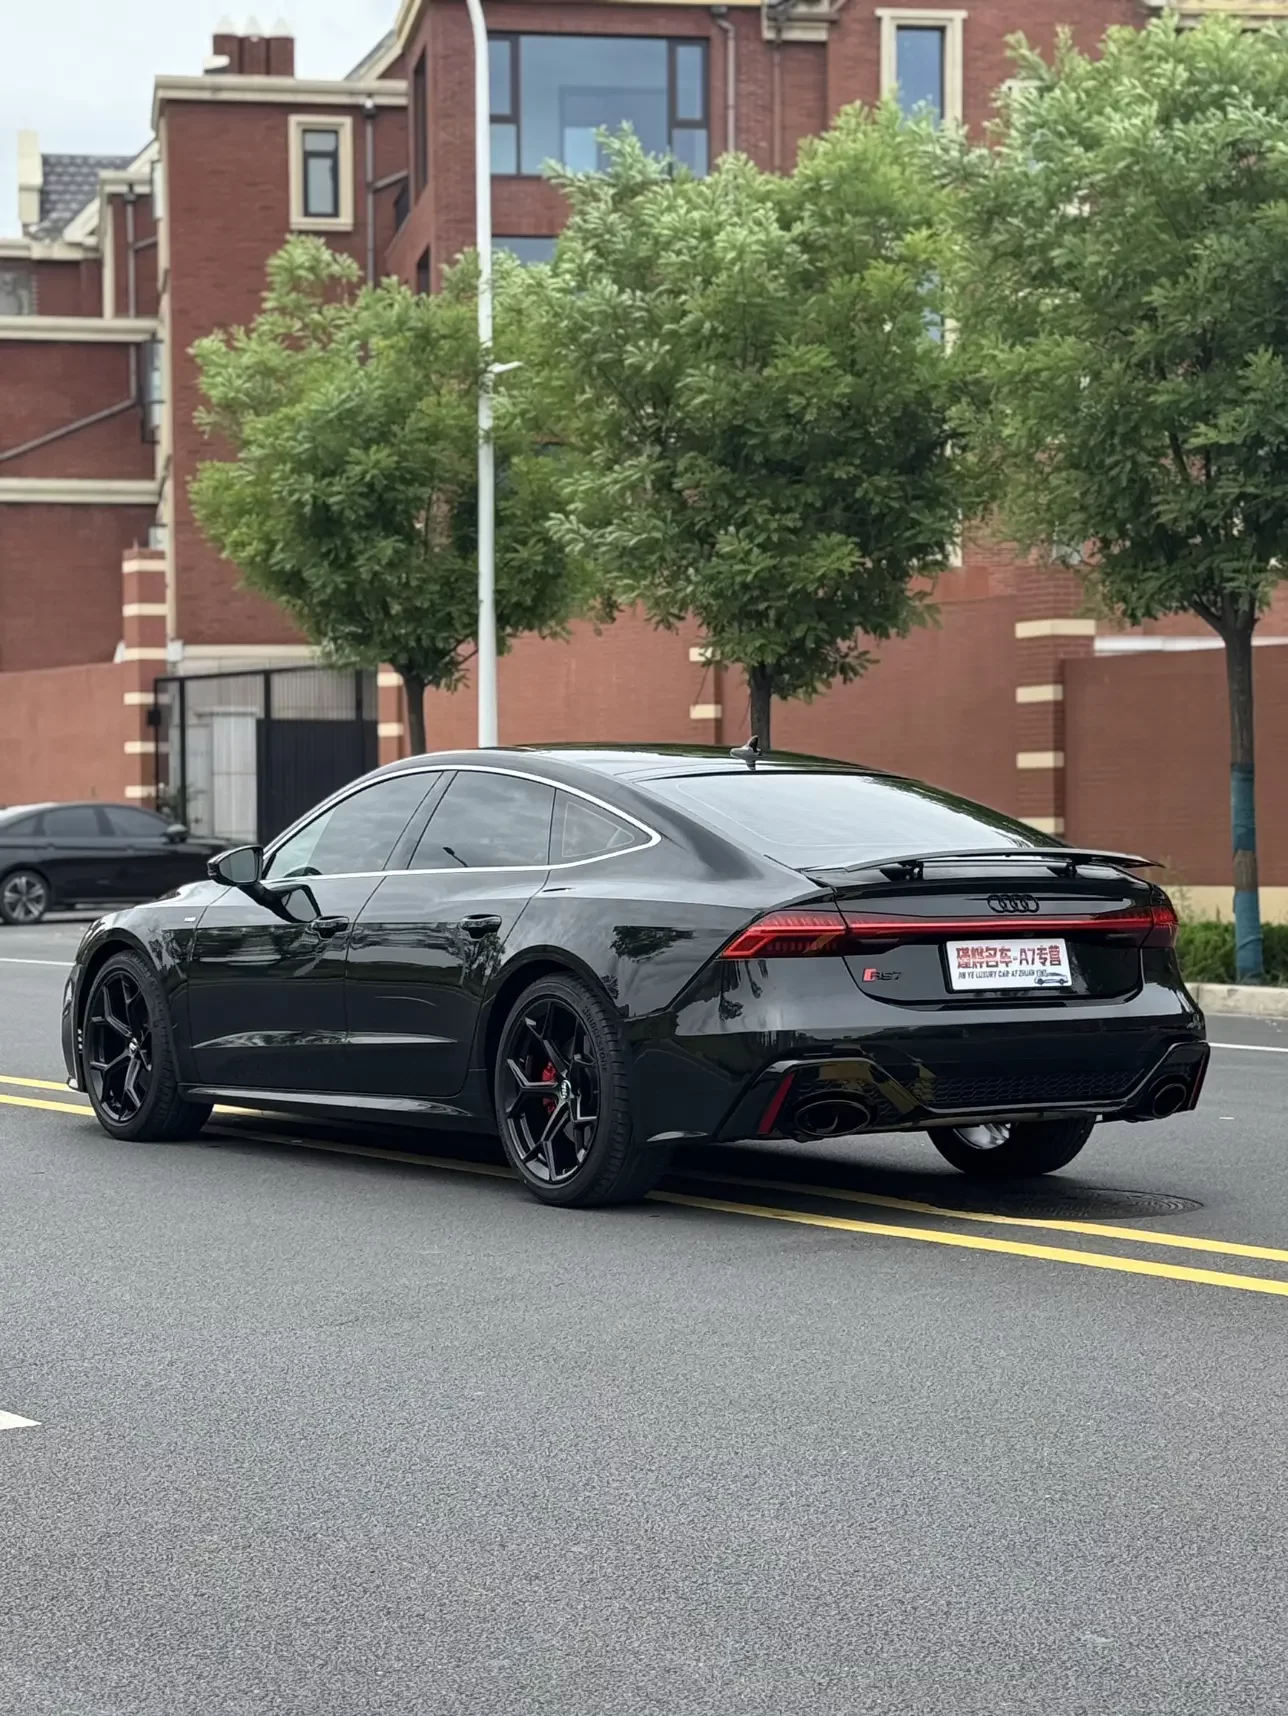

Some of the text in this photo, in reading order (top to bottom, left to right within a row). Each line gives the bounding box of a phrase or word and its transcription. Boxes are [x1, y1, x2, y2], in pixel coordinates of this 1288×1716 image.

[868, 969, 902, 981] RS7
[975, 970, 997, 979] LUXURY
[998, 969, 1010, 978] CAR
